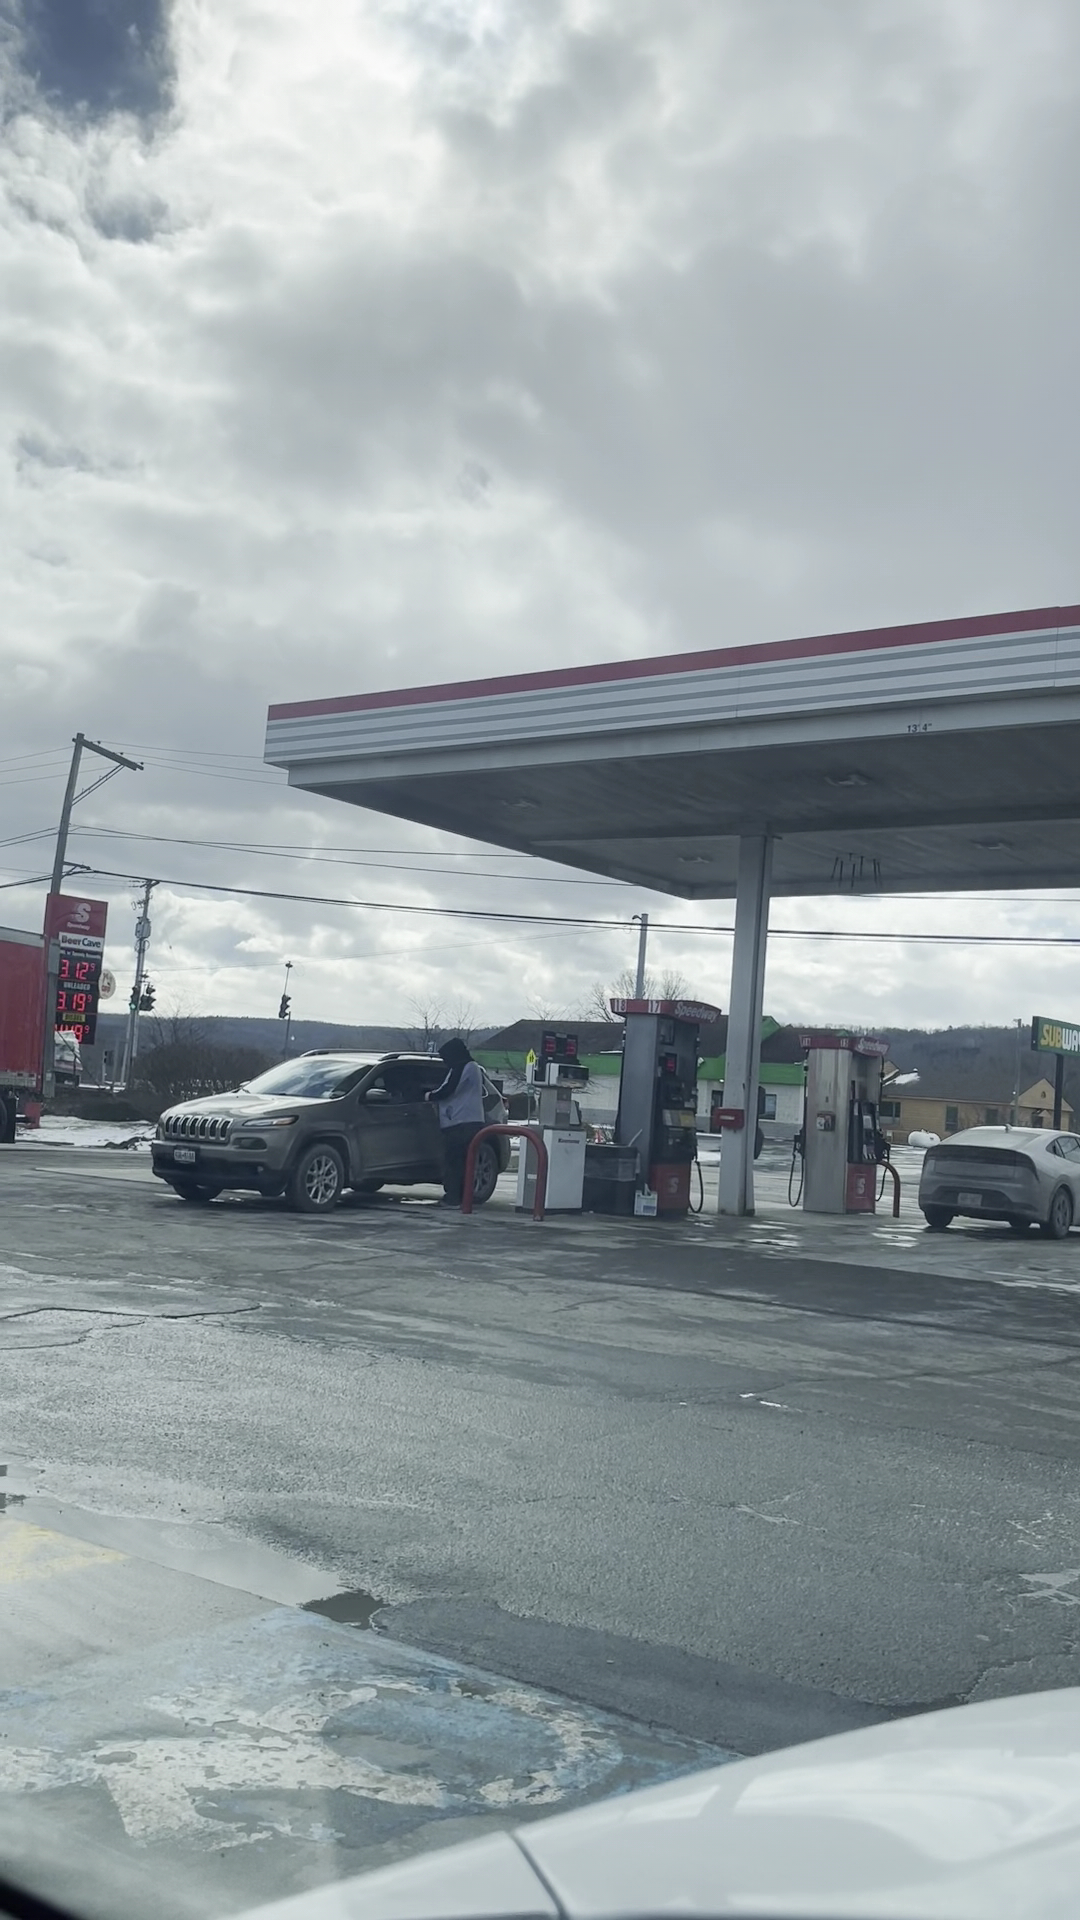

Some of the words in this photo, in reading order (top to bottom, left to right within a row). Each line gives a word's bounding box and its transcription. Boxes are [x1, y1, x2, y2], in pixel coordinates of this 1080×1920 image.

[75, 902, 91, 923] S
[675, 1002, 718, 1023] Speedway
[1040, 1024, 1080, 1052] SUBWA
